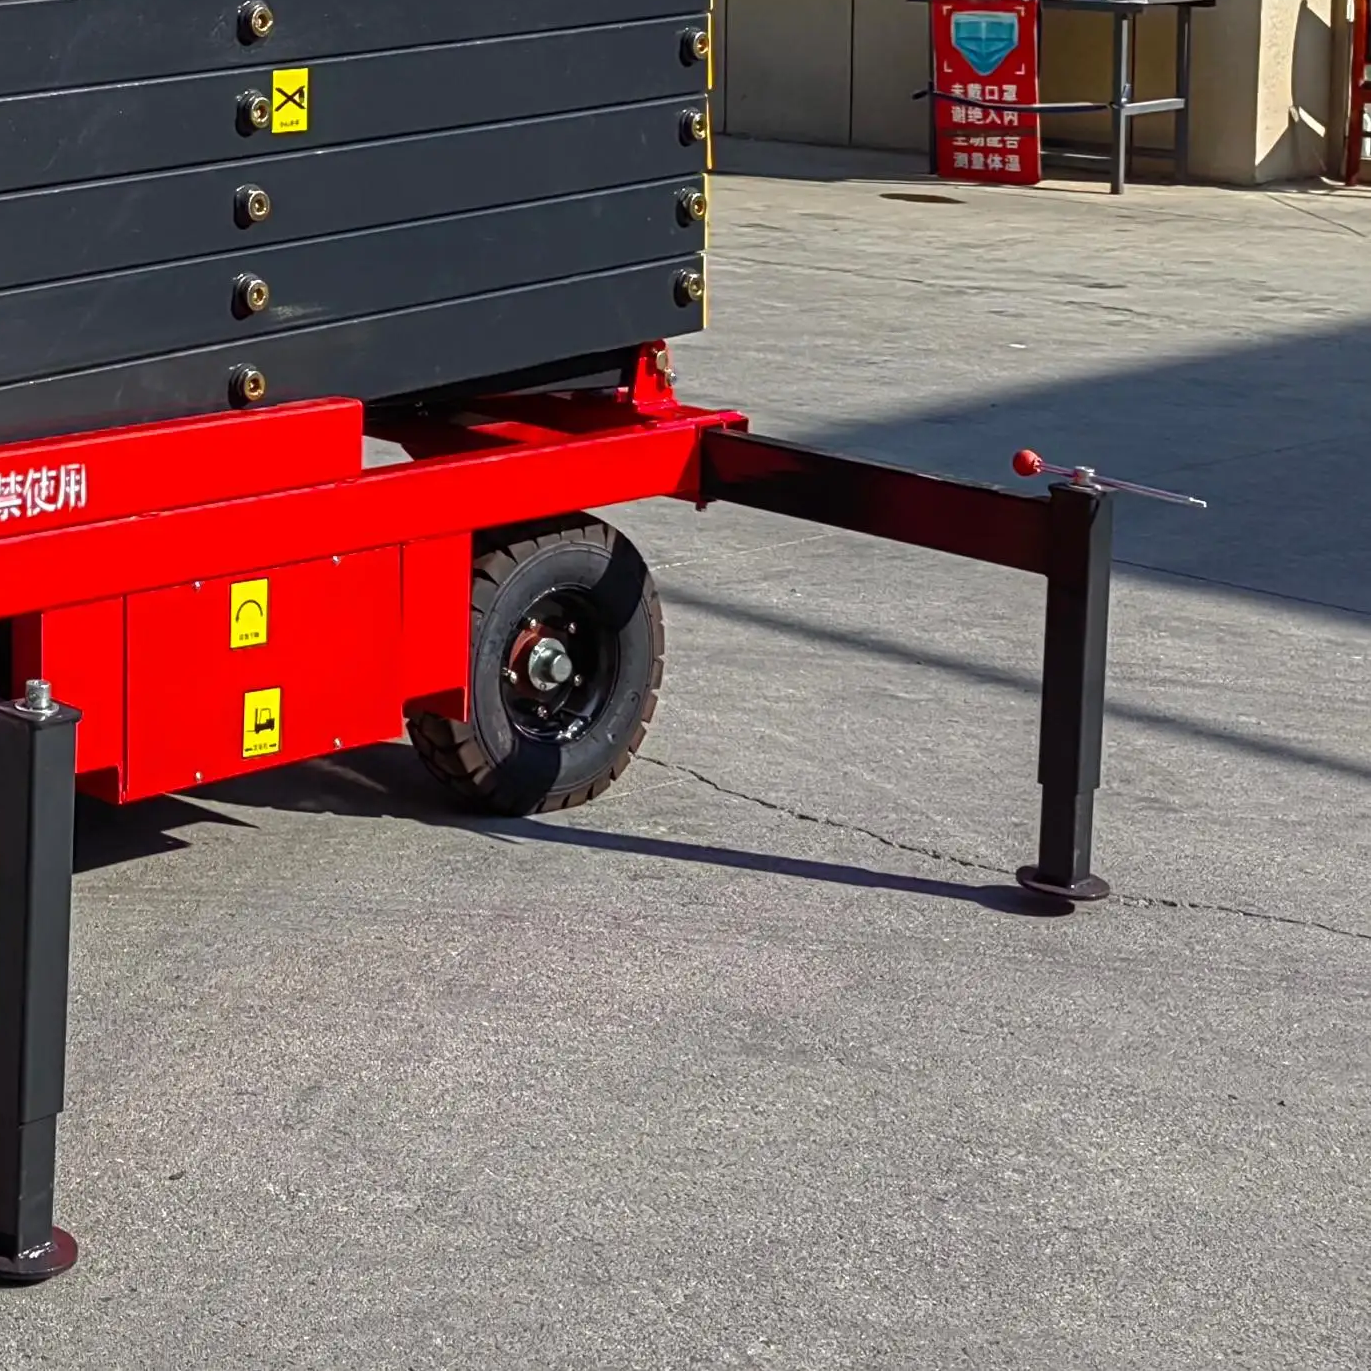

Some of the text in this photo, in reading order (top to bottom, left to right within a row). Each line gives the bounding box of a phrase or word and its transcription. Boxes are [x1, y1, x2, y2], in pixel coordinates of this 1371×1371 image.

[950, 83, 1017, 101] 未戴口罩
[951, 105, 1018, 125] 谢绝入内
[953, 152, 1020, 171] 测量体温
